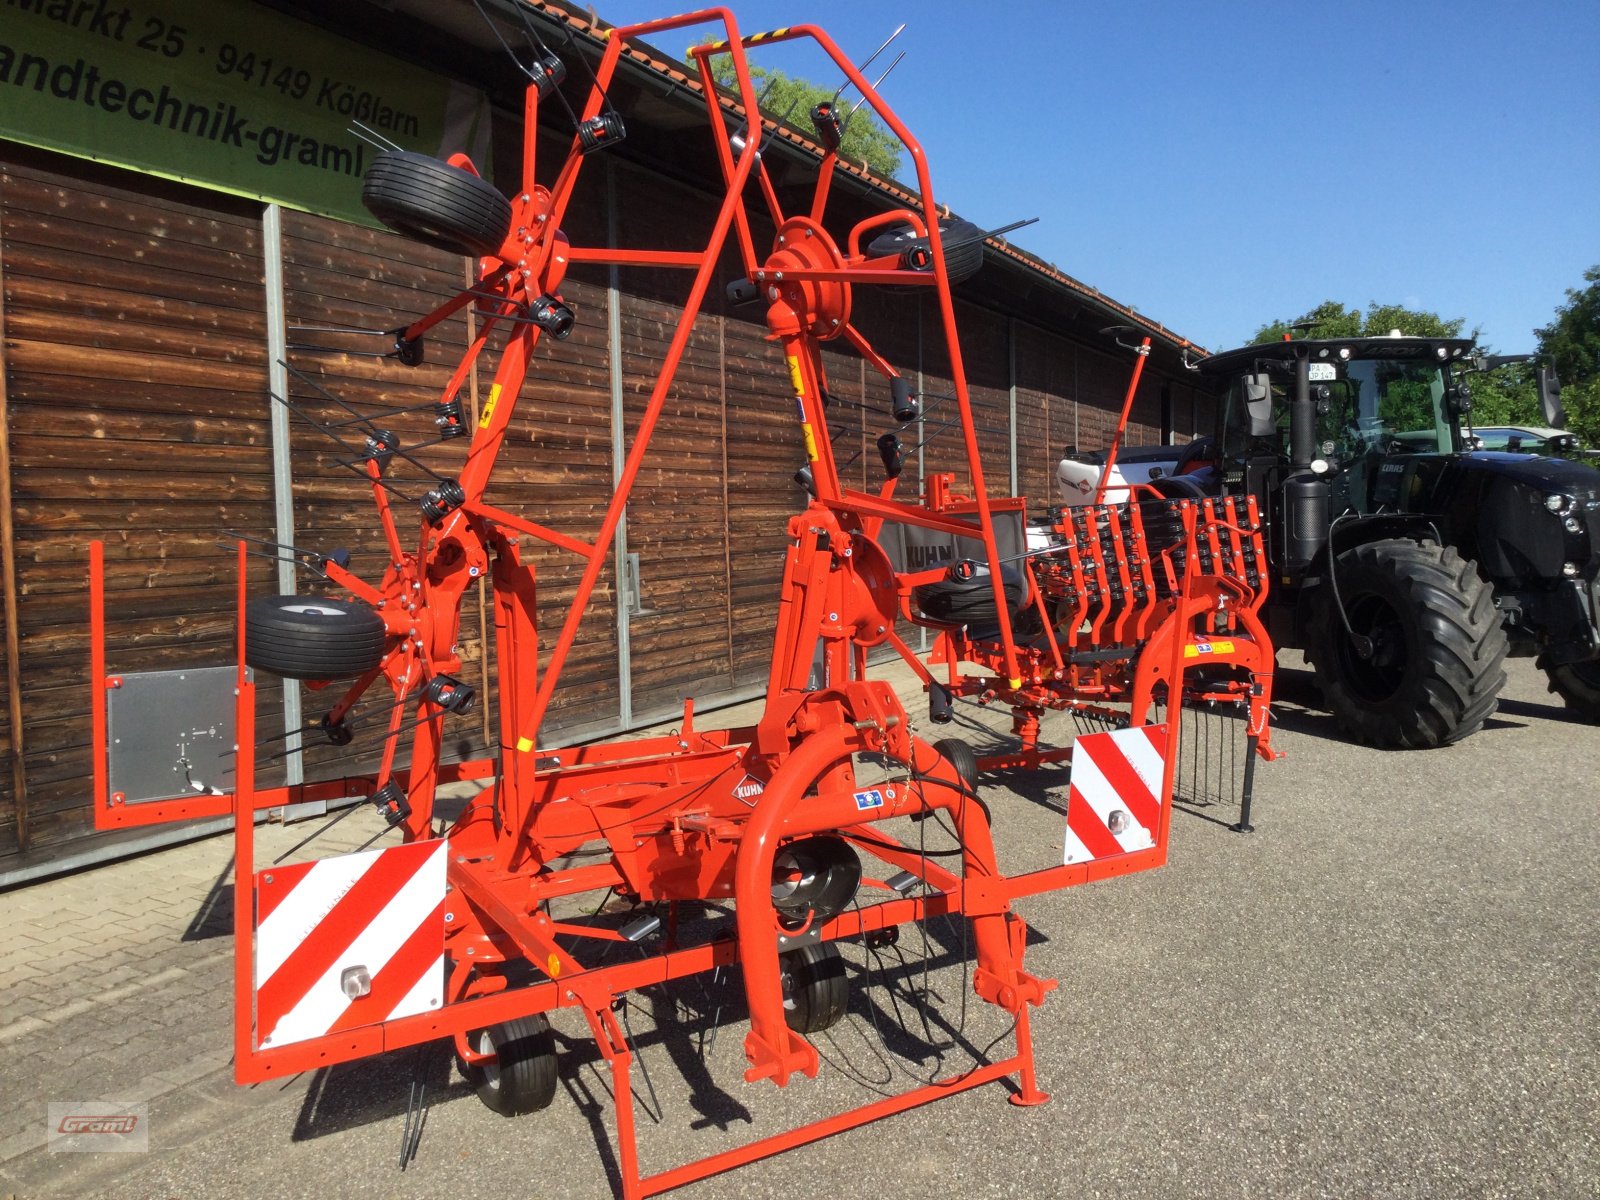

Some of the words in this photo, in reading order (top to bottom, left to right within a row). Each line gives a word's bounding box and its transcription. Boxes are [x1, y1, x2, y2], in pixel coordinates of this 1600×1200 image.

[137, 17, 188, 58] 25
[215, 43, 312, 100] 94149
[316, 77, 420, 138] Kößlarn
[1381, 463, 1405, 473] CLAAS
[906, 545, 952, 569] KUHN
[737, 783, 764, 798] KUHN
